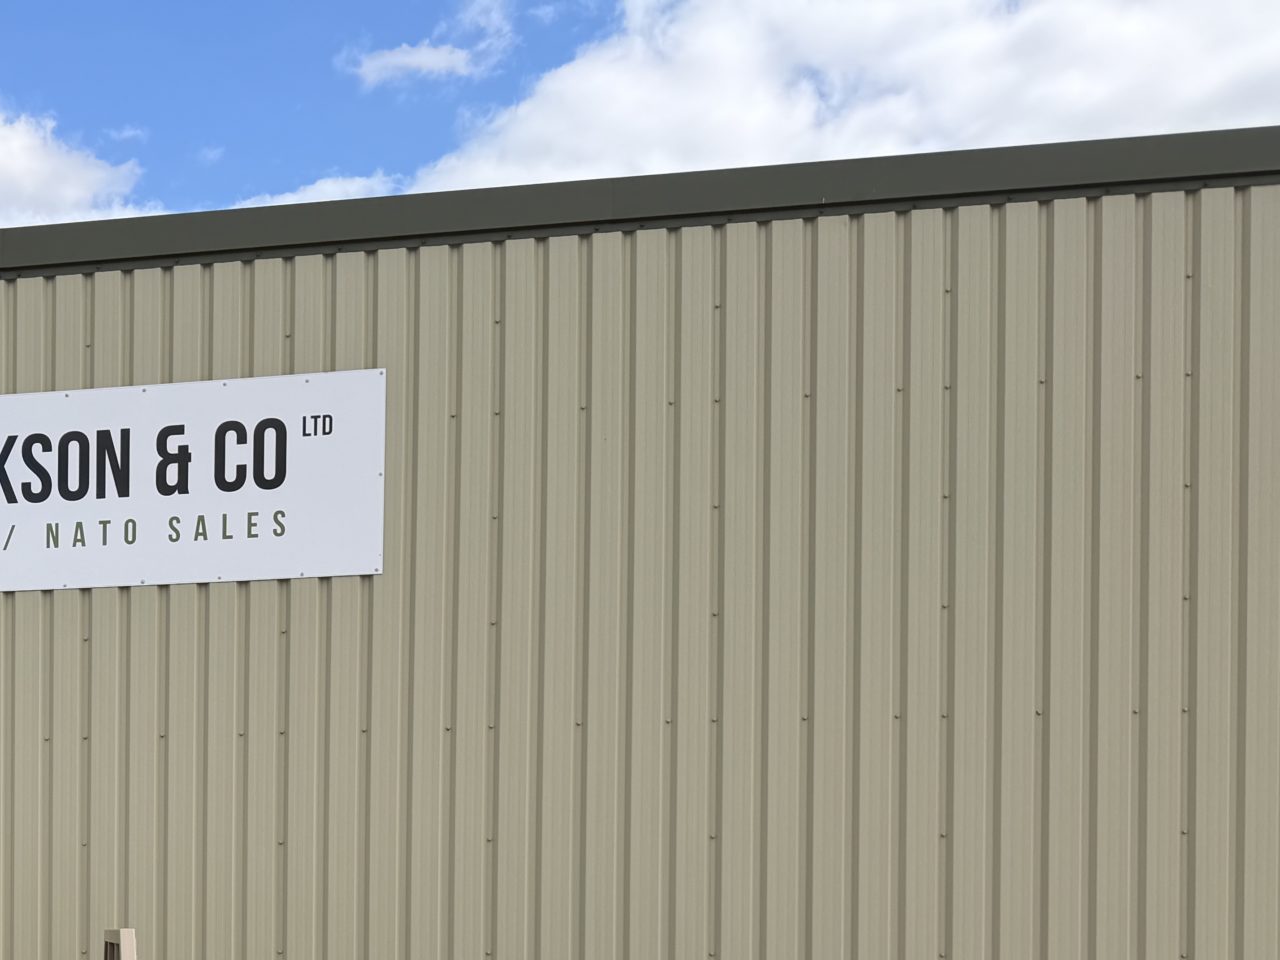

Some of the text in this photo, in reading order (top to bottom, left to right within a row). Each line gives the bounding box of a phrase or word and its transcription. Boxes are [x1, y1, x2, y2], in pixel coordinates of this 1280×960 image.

[155, 423, 192, 497] &
[213, 417, 288, 493] CO
[301, 414, 334, 438] LTD
[2, 524, 16, 551] /
[46, 518, 137, 549] NATO
[167, 509, 286, 543] SALES
